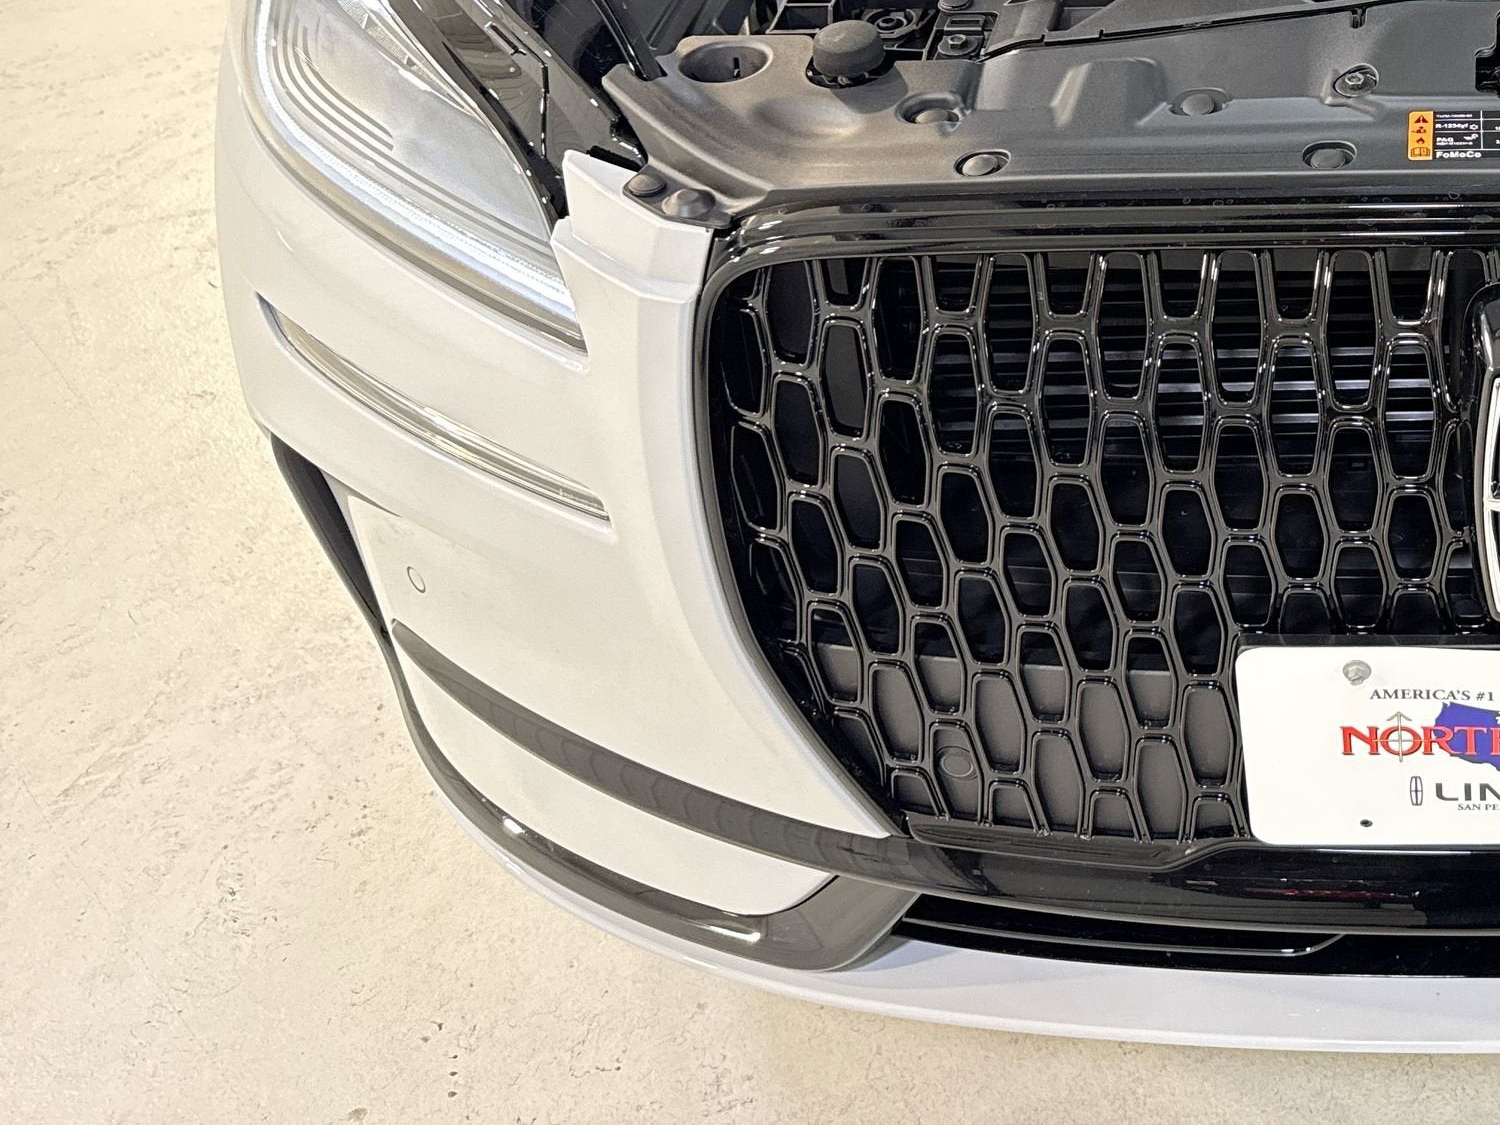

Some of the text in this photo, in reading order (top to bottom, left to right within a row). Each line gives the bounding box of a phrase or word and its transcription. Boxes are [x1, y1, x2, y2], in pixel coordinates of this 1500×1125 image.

[1369, 688, 1471, 701] AMERICA'S
[1476, 691, 1494, 702] #1
[1457, 802, 1481, 811] SAN
